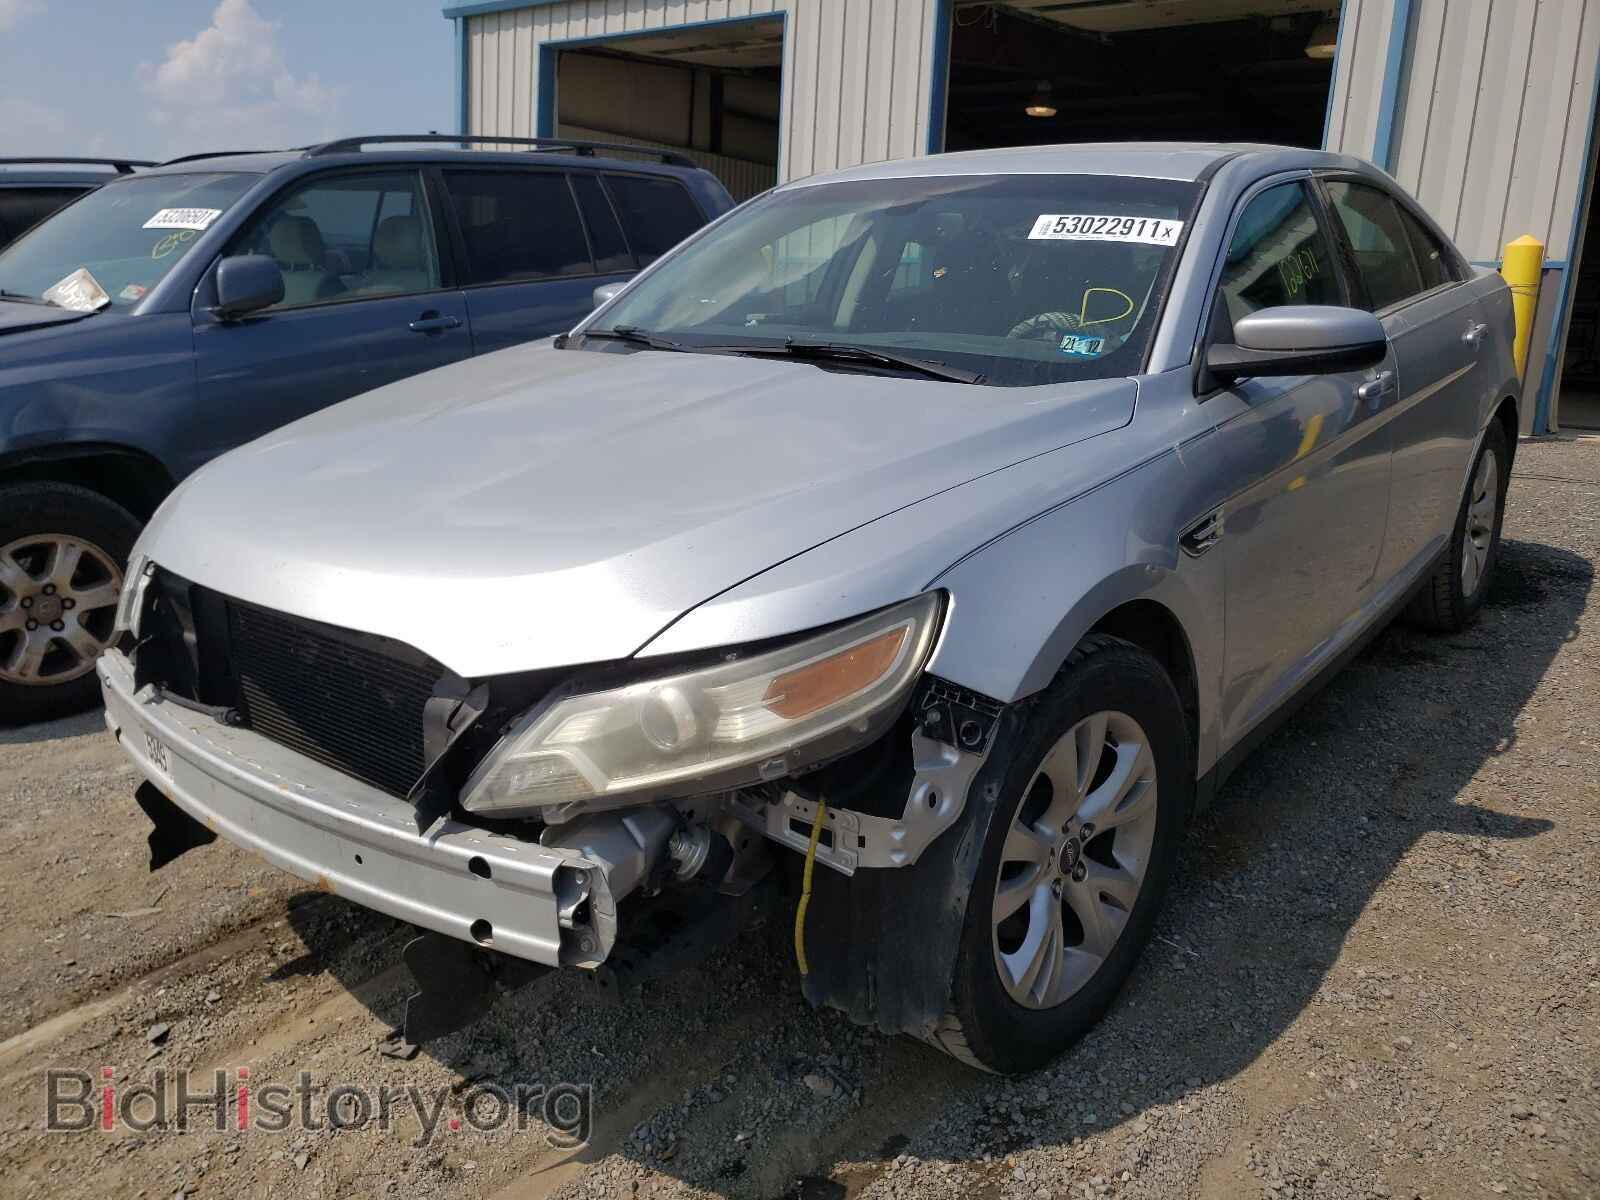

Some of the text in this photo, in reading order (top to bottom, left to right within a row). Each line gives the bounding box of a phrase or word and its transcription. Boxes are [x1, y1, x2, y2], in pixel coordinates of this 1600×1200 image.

[1052, 216, 1161, 238] 53022911
[1079, 287, 1134, 328] D
[1063, 336, 1077, 351] 21
